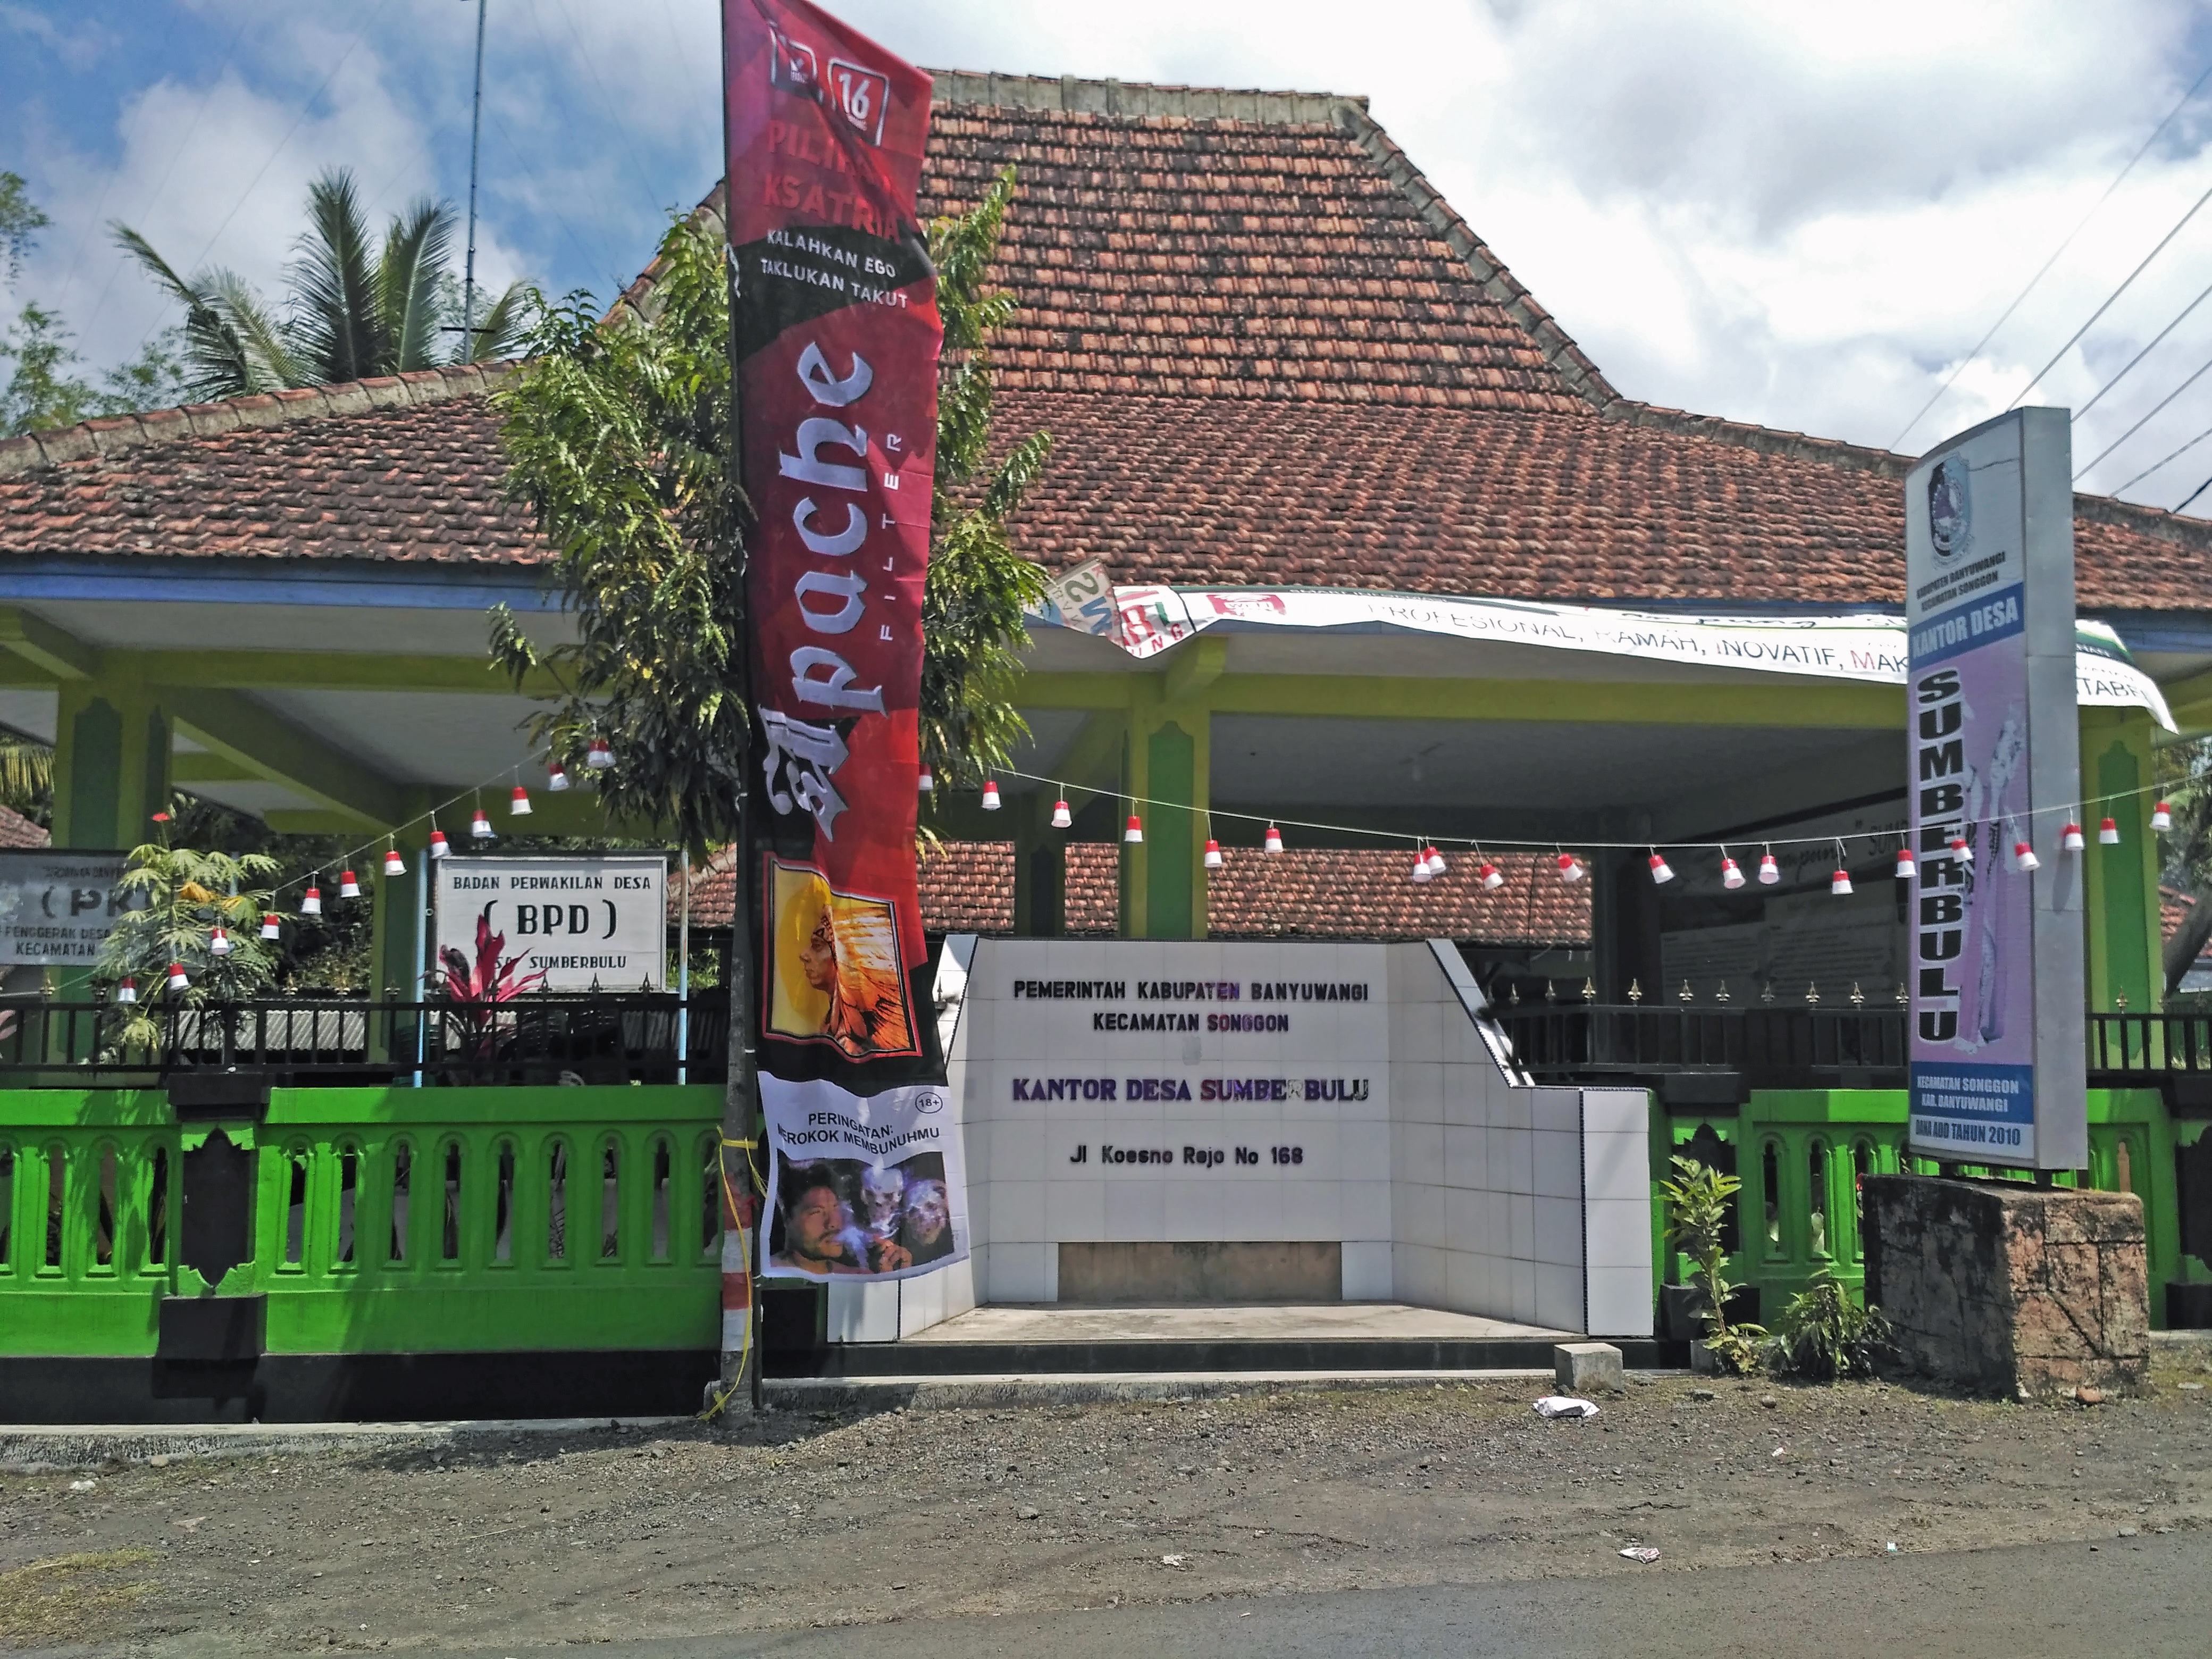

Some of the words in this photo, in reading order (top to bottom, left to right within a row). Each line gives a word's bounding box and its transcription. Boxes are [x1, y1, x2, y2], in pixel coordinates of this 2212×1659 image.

[838, 72, 870, 120] 16
[764, 172, 901, 245] KSATRIA
[767, 229, 858, 269] KALAHKAN
[865, 257, 896, 279] EGO
[760, 258, 844, 291] TAKLUKAN
[851, 281, 908, 309] TAKUT
[879, 433, 902, 642] FILTER
[1369, 604, 1584, 643] ROFESIONAL,
[1914, 616, 1968, 659] KANTOR
[1970, 596, 2019, 636] DESA
[1916, 669, 1964, 1041] SUMBERBULU
[453, 876, 500, 890] BADAN
[510, 876, 603, 890] PERWAKILAN
[614, 876, 651, 890] DESA
[15, 942, 96, 956] KECAMATAN
[529, 956, 627, 969] SUMBERBULU
[1013, 981, 1126, 999] PEMERINTAH
[1138, 982, 1240, 1000] KABUPATEN
[1251, 983, 1369, 1001] BANYUWANGI
[1093, 1013, 1200, 1032] KECAMATAN
[1206, 1013, 1289, 1032] SONGGON
[1012, 1078, 1117, 1101] KANTOR
[1126, 1079, 1192, 1101] DESA
[1963, 1078, 2019, 1093] SONGGON
[919, 1098, 940, 1107] 18+
[1939, 1094, 2008, 1112] BANYUWANGI
[808, 1112, 894, 1138] PERINGATAN:
[1951, 1122, 1986, 1143] TAHUN
[1988, 1126, 2021, 1146] 2010
[843, 1127, 940, 1155] MEMBUNUHMU
[1101, 1145, 1174, 1164] Koesno
[1235, 1146, 1259, 1165] No
[1271, 1146, 1303, 1165] 168
